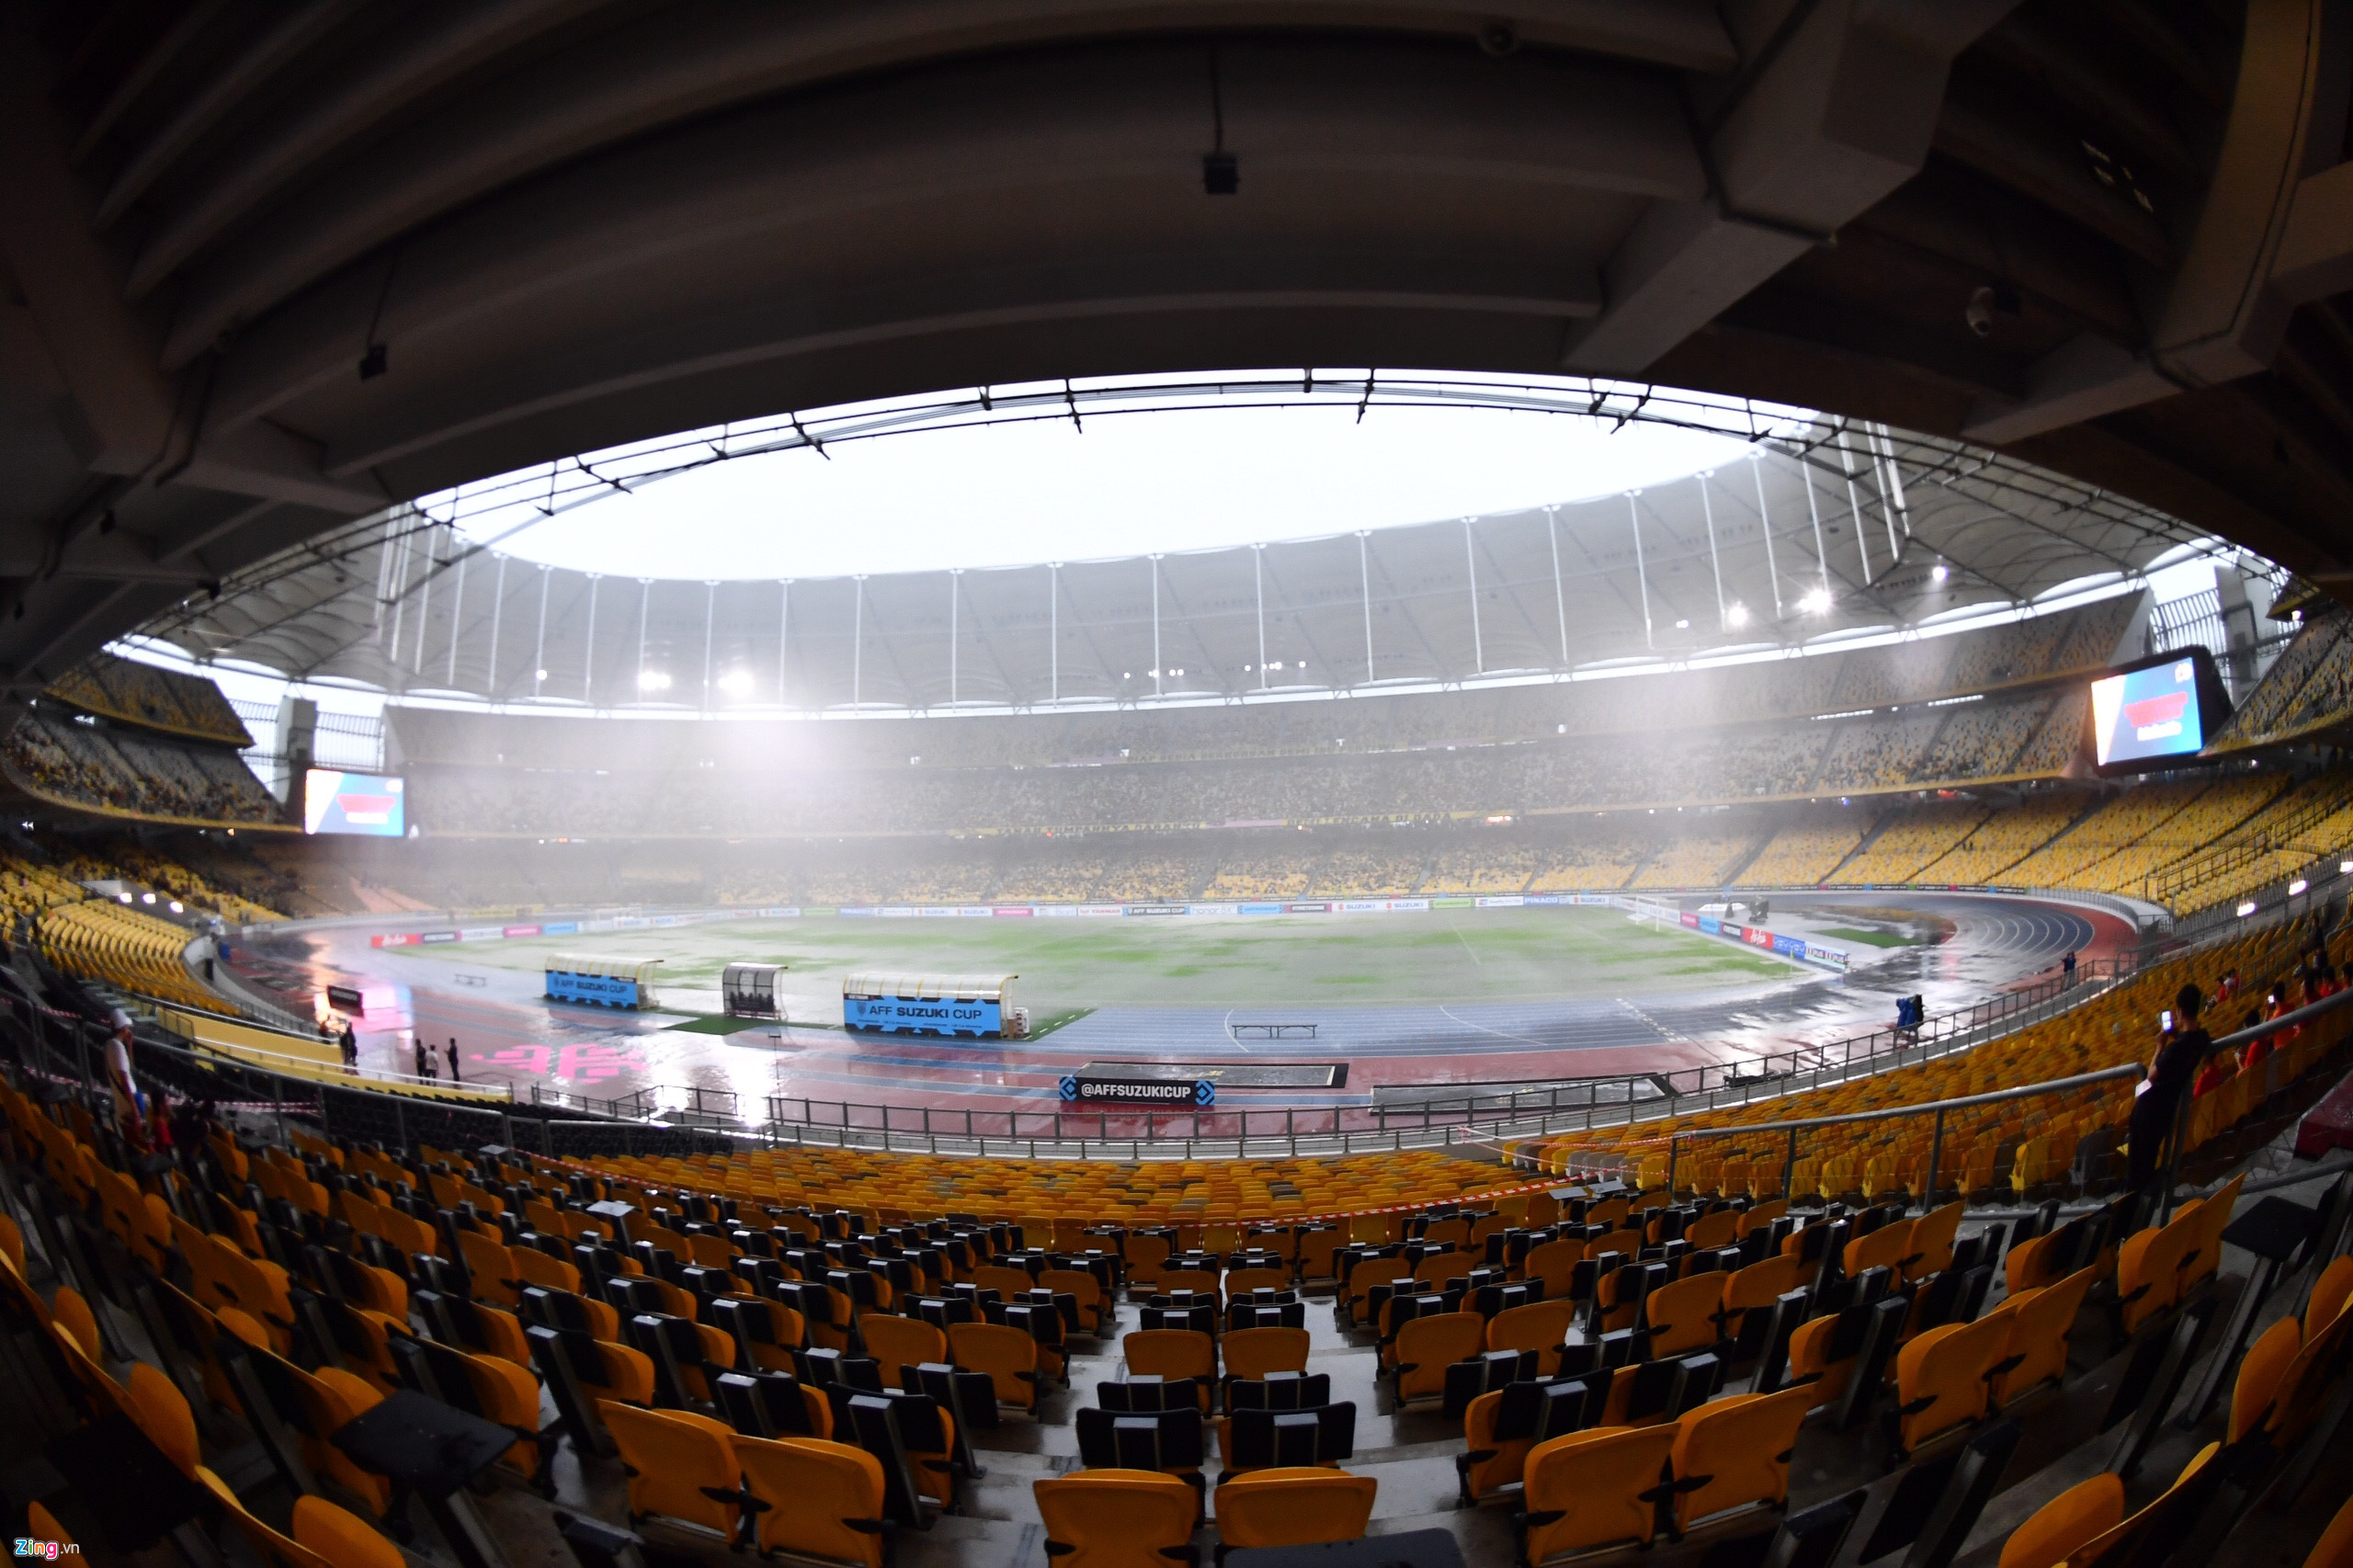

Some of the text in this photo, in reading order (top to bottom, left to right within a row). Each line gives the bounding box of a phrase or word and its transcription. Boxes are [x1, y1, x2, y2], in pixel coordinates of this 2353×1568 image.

[576, 981, 608, 992] SUZUKI
[608, 983, 628, 994] CUP
[869, 1006, 983, 1020] AFF SUZUKI CUP
[1081, 1083, 1191, 1098] @AFFSUZUKICUP
